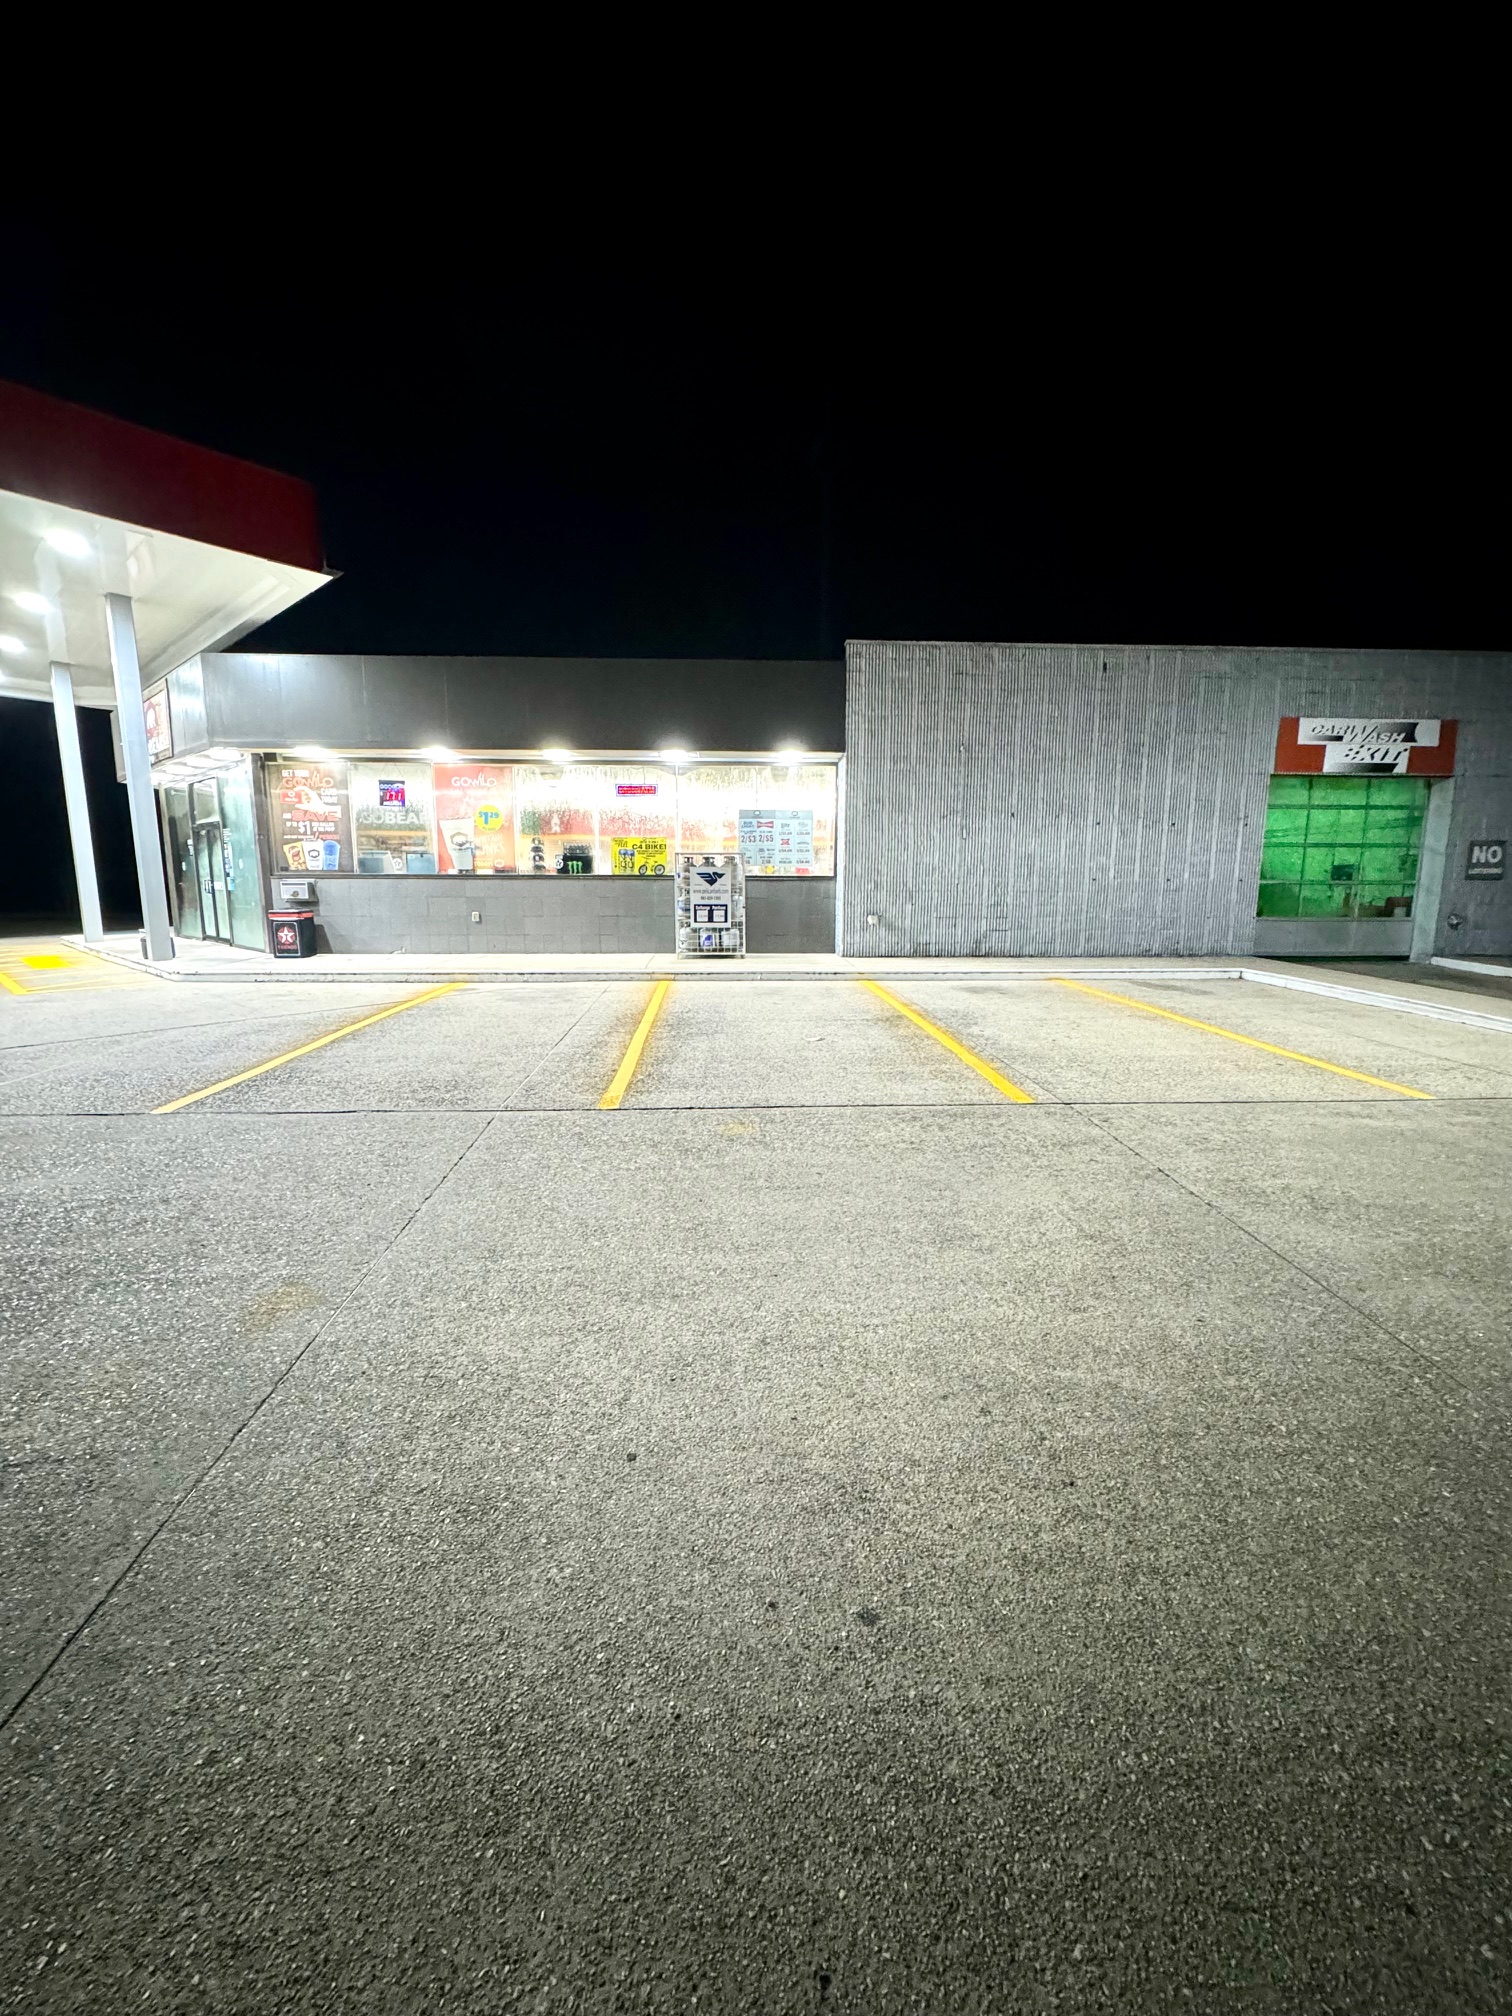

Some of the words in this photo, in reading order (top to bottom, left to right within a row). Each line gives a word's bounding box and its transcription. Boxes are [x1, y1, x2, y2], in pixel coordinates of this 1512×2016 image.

[1344, 745, 1408, 762] EXIT
[281, 769, 293, 778] GET
[291, 809, 340, 821] SAVE
[298, 820, 311, 835] $1
[1471, 845, 1503, 864] NO
